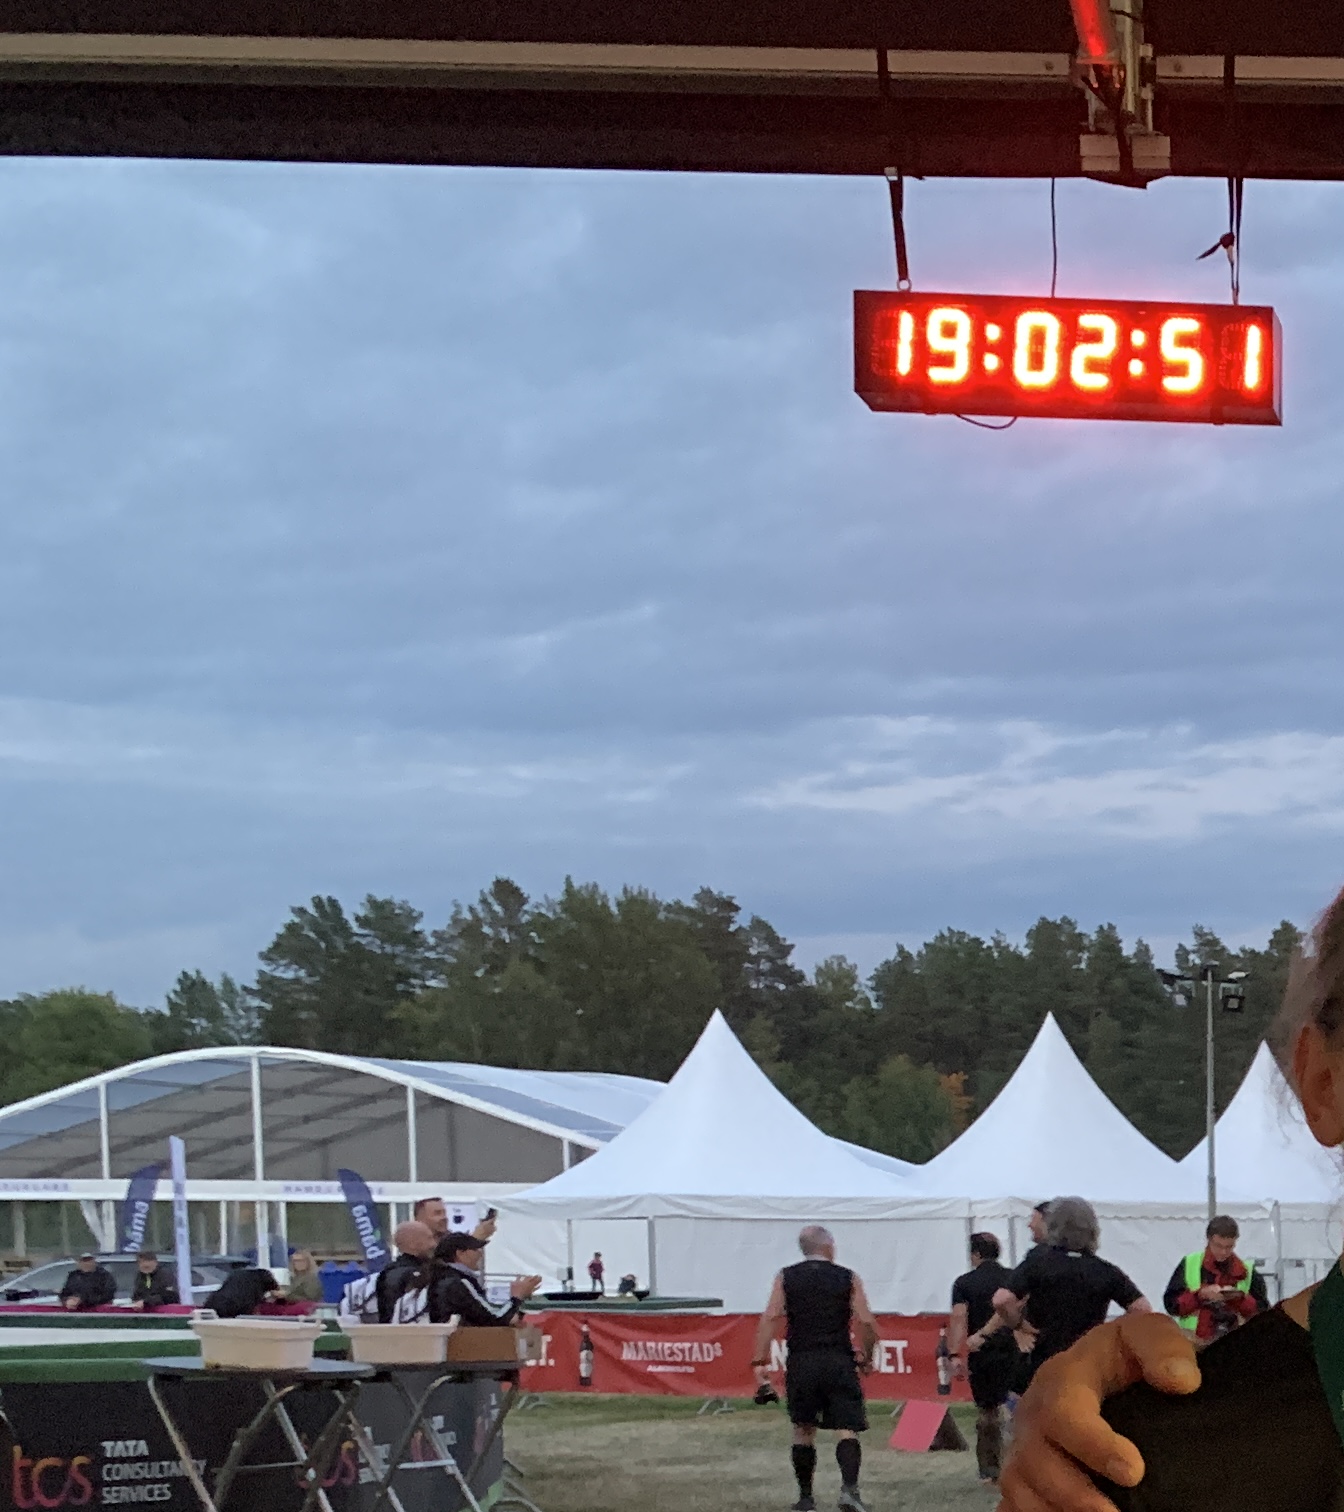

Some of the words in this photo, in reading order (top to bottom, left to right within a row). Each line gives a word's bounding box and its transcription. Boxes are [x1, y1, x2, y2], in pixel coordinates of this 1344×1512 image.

[896, 306, 1262, 393] 19:02:51
[101, 1439, 149, 1458] TATA
[12, 1444, 94, 1509] tcs
[102, 1483, 172, 1504] SERVICES
